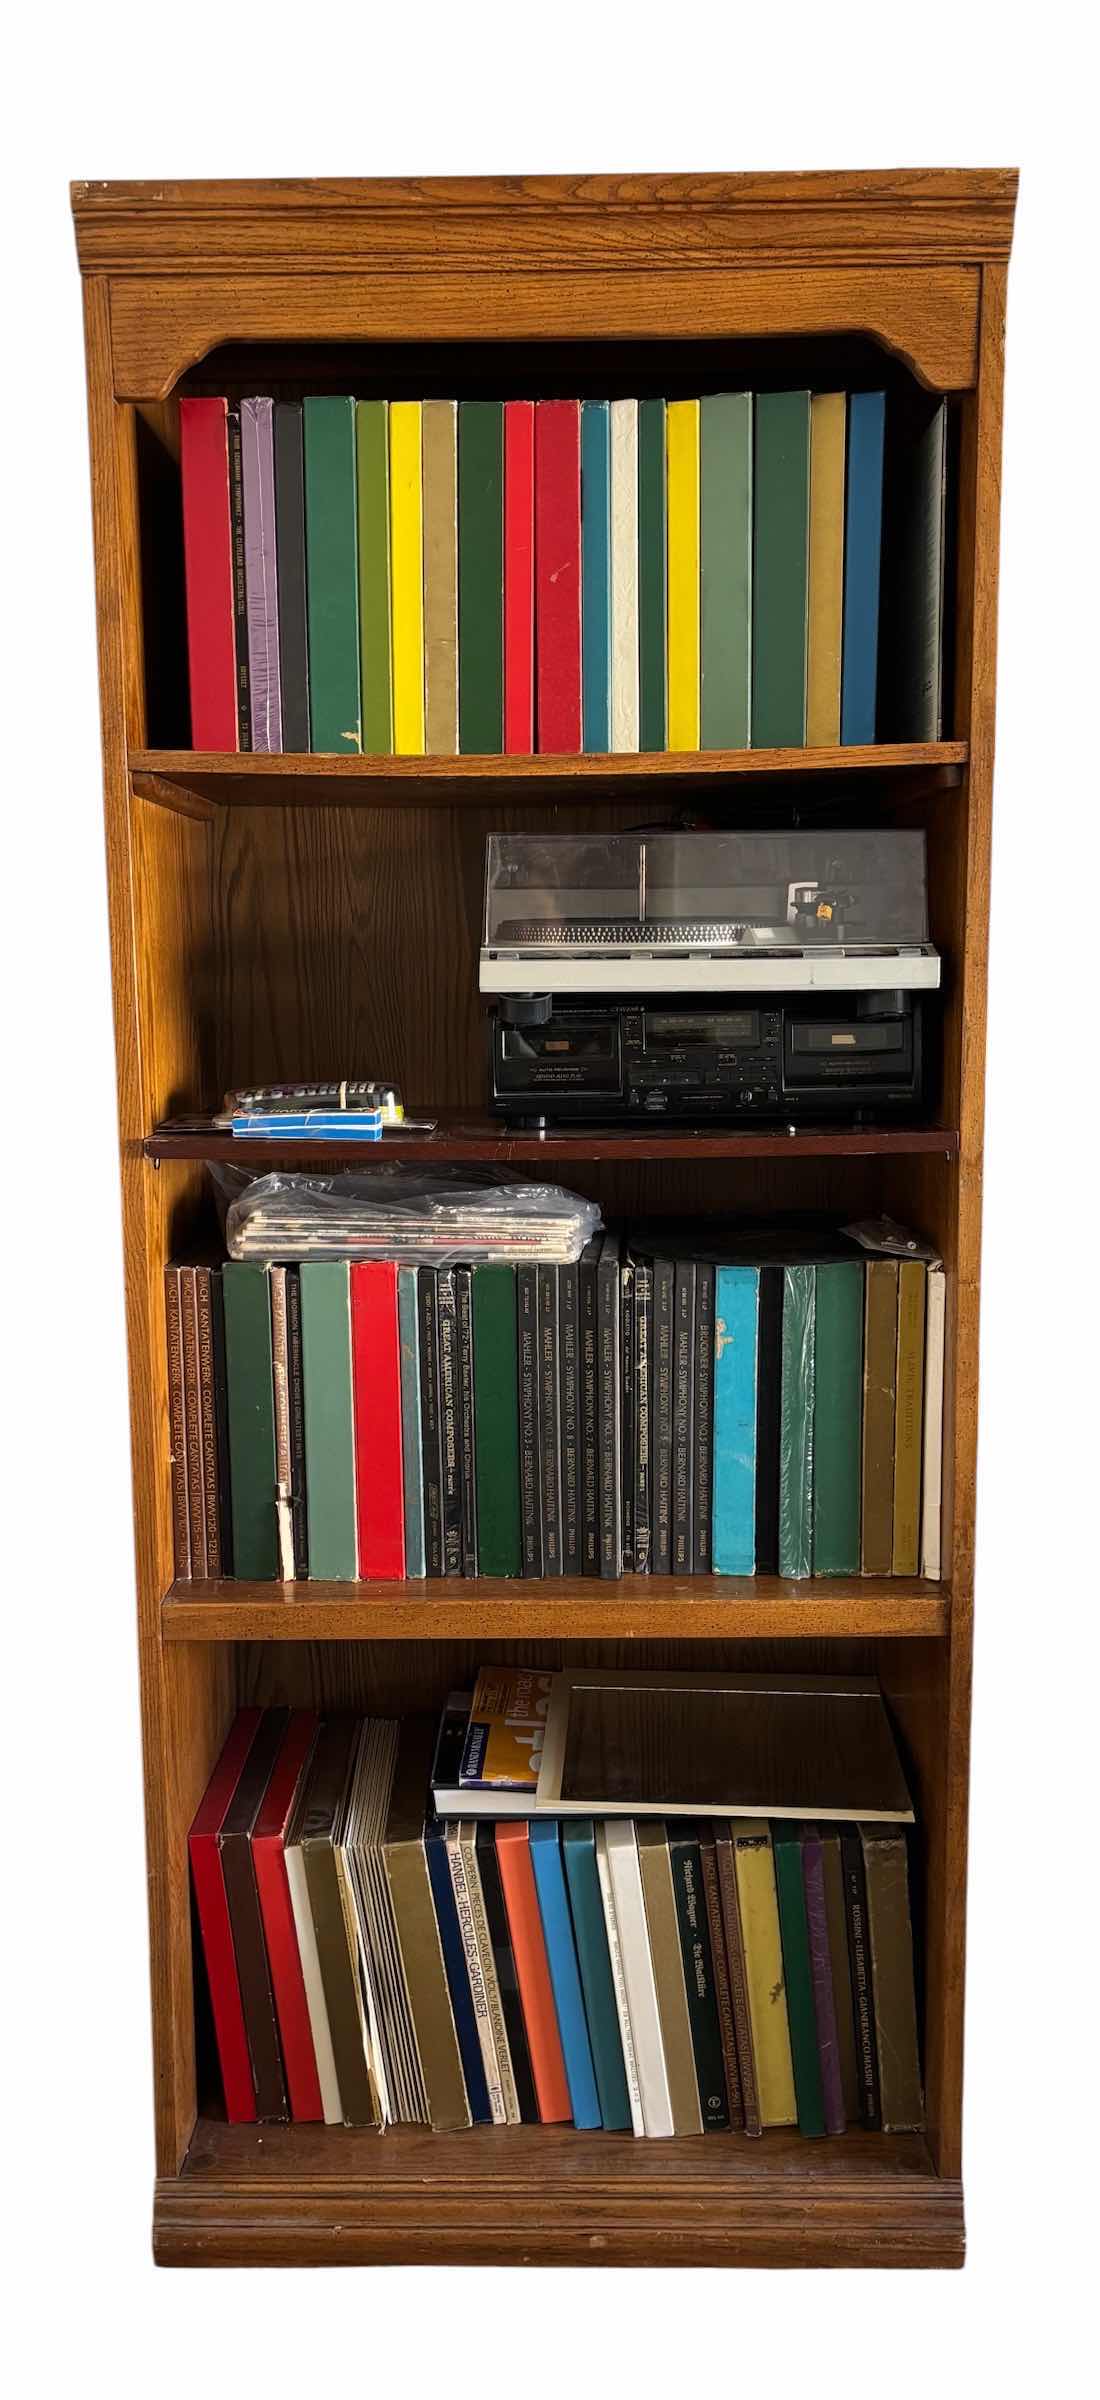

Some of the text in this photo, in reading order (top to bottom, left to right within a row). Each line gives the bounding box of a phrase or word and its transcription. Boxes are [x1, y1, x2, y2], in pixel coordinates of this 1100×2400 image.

[169, 1277, 178, 1303] BACH
[184, 1277, 193, 1303] BACH
[200, 1276, 209, 1302] BACH
[461, 1304, 469, 1320] Best
[169, 1308, 181, 1385] KANTATENWERK
[185, 1308, 196, 1385] KANTATENWERK
[201, 1308, 211, 1385] KANTATENWERK
[442, 1319, 452, 1353] GREAT
[522, 1331, 532, 1366] MAHLER
[544, 1327, 553, 1361] MAHLER
[565, 1323, 575, 1358] MAHLER
[584, 1329, 594, 1364] MAHLER
[603, 1327, 613, 1362] MAHLER
[639, 1315, 648, 1349] GREAT
[659, 1325, 669, 1360] MAHLER
[679, 1332, 689, 1366] MAHLER
[700, 1325, 710, 1369] BRUCKNER
[292, 1332, 300, 1376] TABERNACLE
[460, 1345, 470, 1362] Terry
[443, 1354, 454, 1407] AMERICAN
[544, 1370, 554, 1418] SYMPHONY
[565, 1365, 575, 1412] SYMPHONY
[585, 1369, 595, 1416] SYMPHONY
[603, 1369, 613, 1416] SYMPHONY
[639, 1350, 648, 1403] AMERICAN
[659, 1367, 669, 1414] SYMPHONY
[679, 1370, 689, 1417] SYMPHONY
[699, 1372, 709, 1417] SYMPHONY
[523, 1372, 533, 1421] SYMPHONY
[172, 1391, 184, 1441] COMPLETE
[187, 1391, 199, 1441] COMPLETE
[203, 1390, 214, 1440] COMPLETE
[463, 1403, 472, 1437] Orchestra
[903, 1390, 914, 1449] TRADITIONS
[445, 1408, 456, 1467] COMPOSERS
[463, 1438, 472, 1452] and
[639, 1405, 649, 1465] COMPOSERS
[175, 1441, 185, 1490] CANTATAS
[190, 1441, 200, 1490] CANTATAS
[205, 1440, 216, 1489] CANTATAS
[463, 1454, 472, 1480] Chorus
[524, 1449, 534, 1490] BERNARD
[545, 1449, 555, 1488] BERNARD
[566, 1447, 575, 1488] BERNARD
[586, 1448, 595, 1488] BERNARD
[604, 1451, 613, 1491] BERNARD
[659, 1448, 669, 1489] BERNARD
[677, 1447, 687, 1487] BERNARD
[699, 1445, 708, 1485] BERNARD
[177, 1495, 186, 1518] BWV
[192, 1496, 201, 1519] BWV
[208, 1494, 217, 1516] BWV
[525, 1491, 534, 1525] HAITINK
[546, 1489, 556, 1522] HAITINK
[567, 1489, 576, 1524] HAITINK
[586, 1489, 595, 1522] HAITINK
[604, 1493, 613, 1528] HAITINK
[658, 1490, 668, 1524] HAITINK
[677, 1488, 687, 1521] HAITINK
[699, 1486, 708, 1520] HAITINK
[548, 1532, 557, 1559] PHILIPS
[587, 1532, 595, 1559] PHILIPS
[602, 1533, 612, 1561] PHILIPS
[677, 1535, 685, 1562] PHILIPS
[699, 1529, 707, 1556] PHILIPS
[463, 1846, 480, 1888] COUPERIN
[682, 1860, 695, 1894] Richard
[477, 1919, 486, 1931] DE
[686, 1895, 698, 1928] Wagner
[851, 1903, 863, 1939] ROSSINI
[450, 1852, 467, 1897] HANDEL
[460, 1901, 479, 1957] HERCULES
[470, 1961, 488, 2019] GARDINER
[480, 1932, 494, 1972] CLAVECIN
[692, 1943, 703, 1957] Die
[716, 1959, 729, 2006] COMPLETE
[855, 1944, 867, 1992] ELISABETTA
[722, 2007, 736, 2055] CANTATAS
[858, 1996, 871, 2053] GIANFRANCO
[499, 2044, 510, 2073] VERLET
[863, 2054, 873, 2086] MASINI
